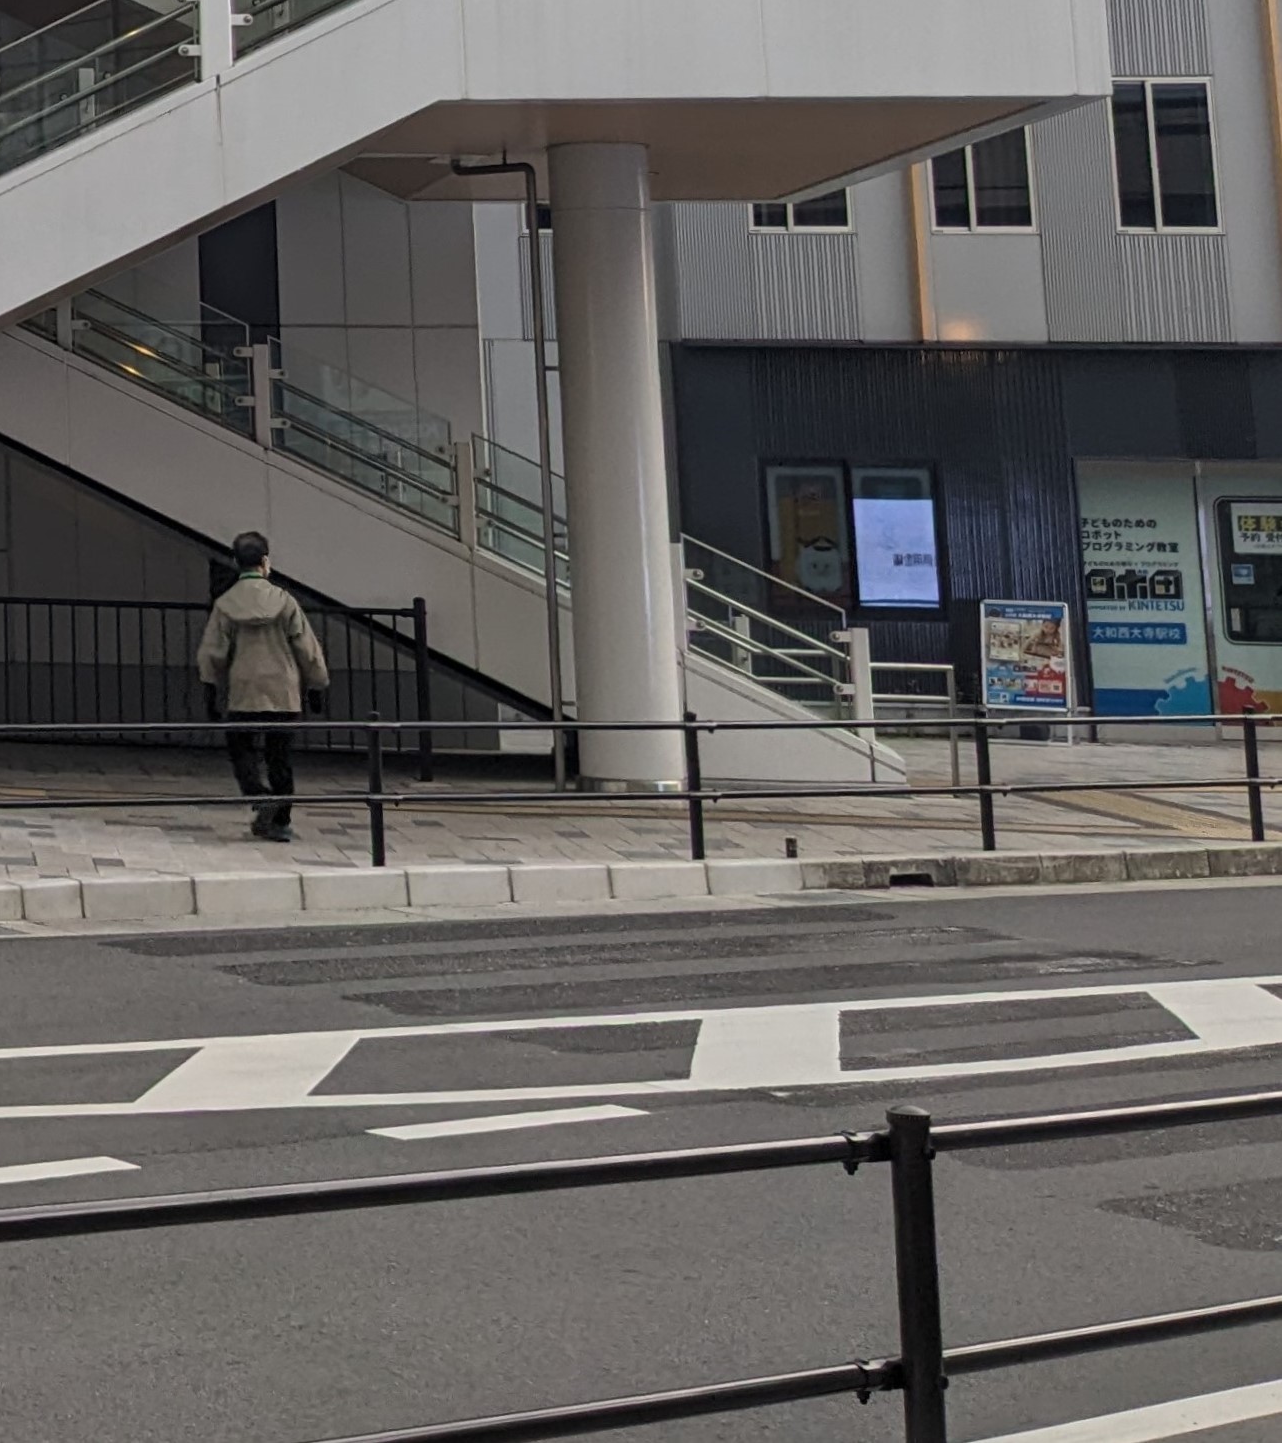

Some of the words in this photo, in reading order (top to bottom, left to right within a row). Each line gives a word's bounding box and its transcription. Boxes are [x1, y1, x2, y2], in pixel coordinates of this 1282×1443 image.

[1239, 515, 1282, 532] 体験
[1128, 600, 1184, 611] KINTETSU
[1093, 627, 1182, 640] 大和西大寺駅校
